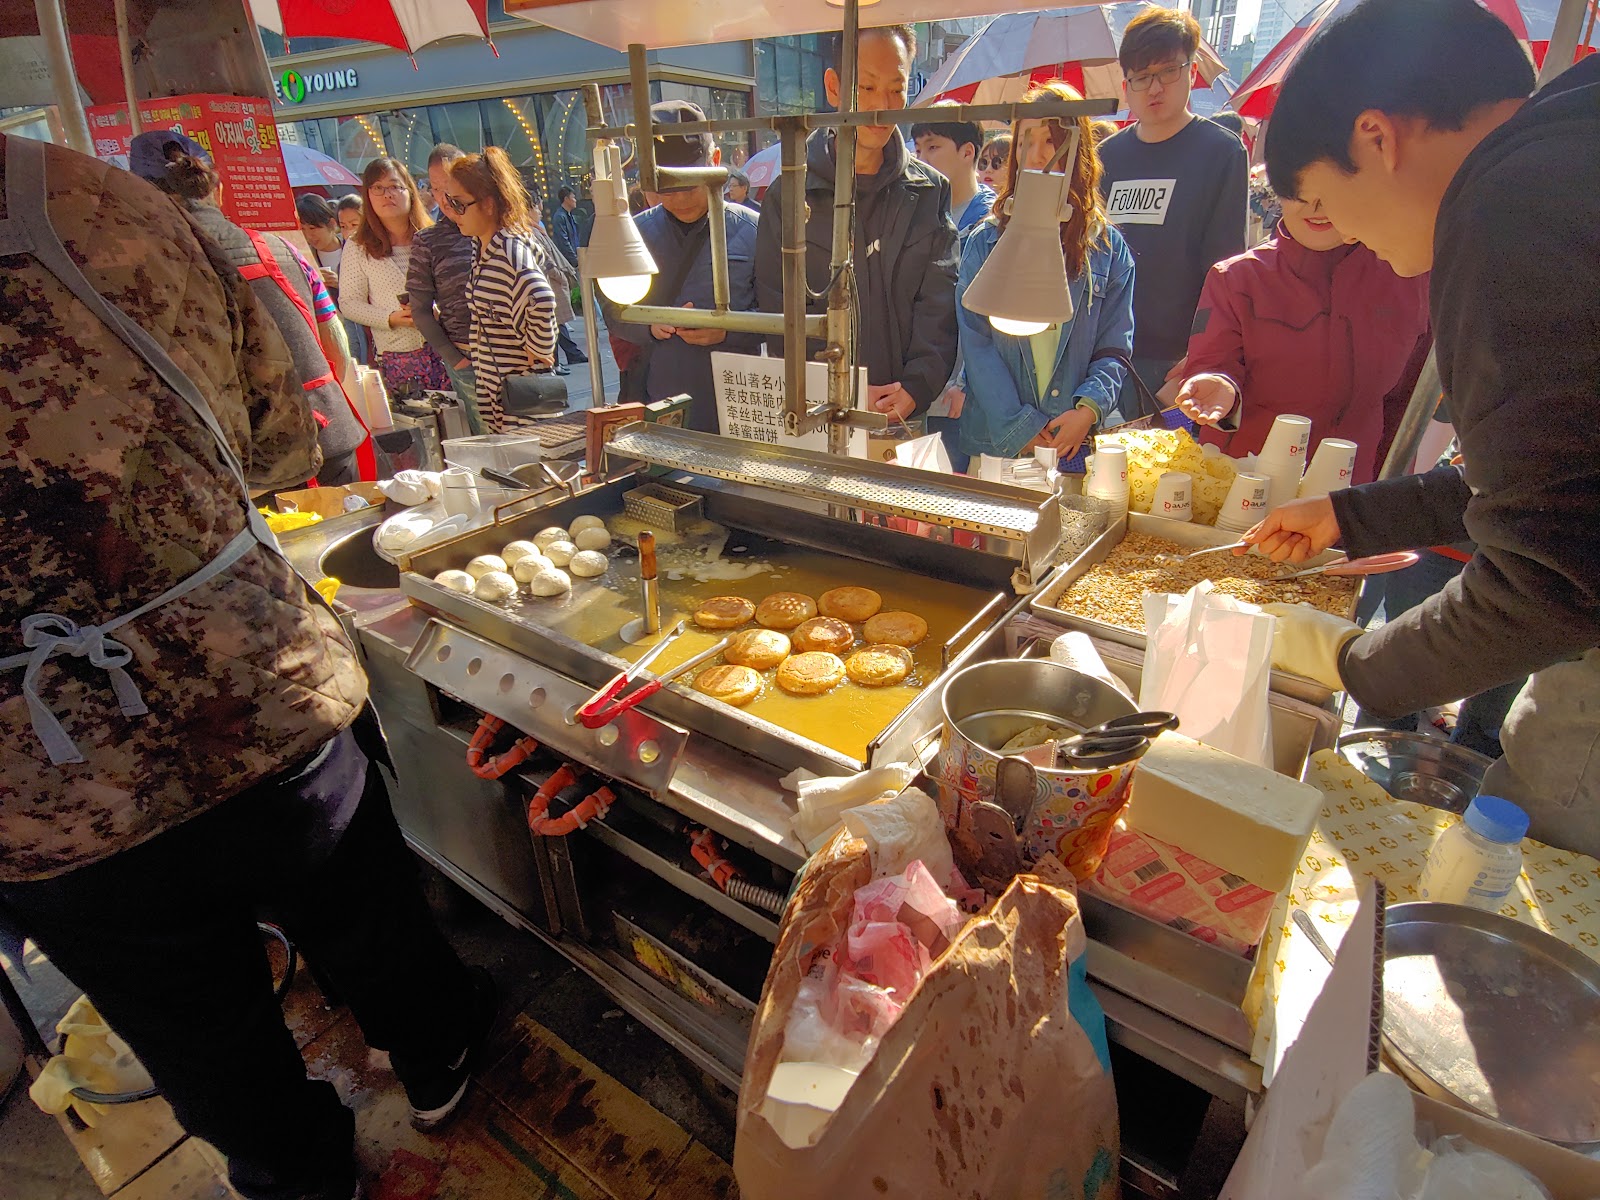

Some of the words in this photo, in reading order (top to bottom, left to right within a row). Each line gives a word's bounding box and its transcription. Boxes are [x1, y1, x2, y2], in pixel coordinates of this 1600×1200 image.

[303, 69, 357, 92] YOUNG
[214, 121, 247, 149] 아저씨
[243, 117, 262, 154] 씨앗
[258, 123, 279, 151] 호떡
[728, 421, 778, 444] 蜂蜜甜饼
